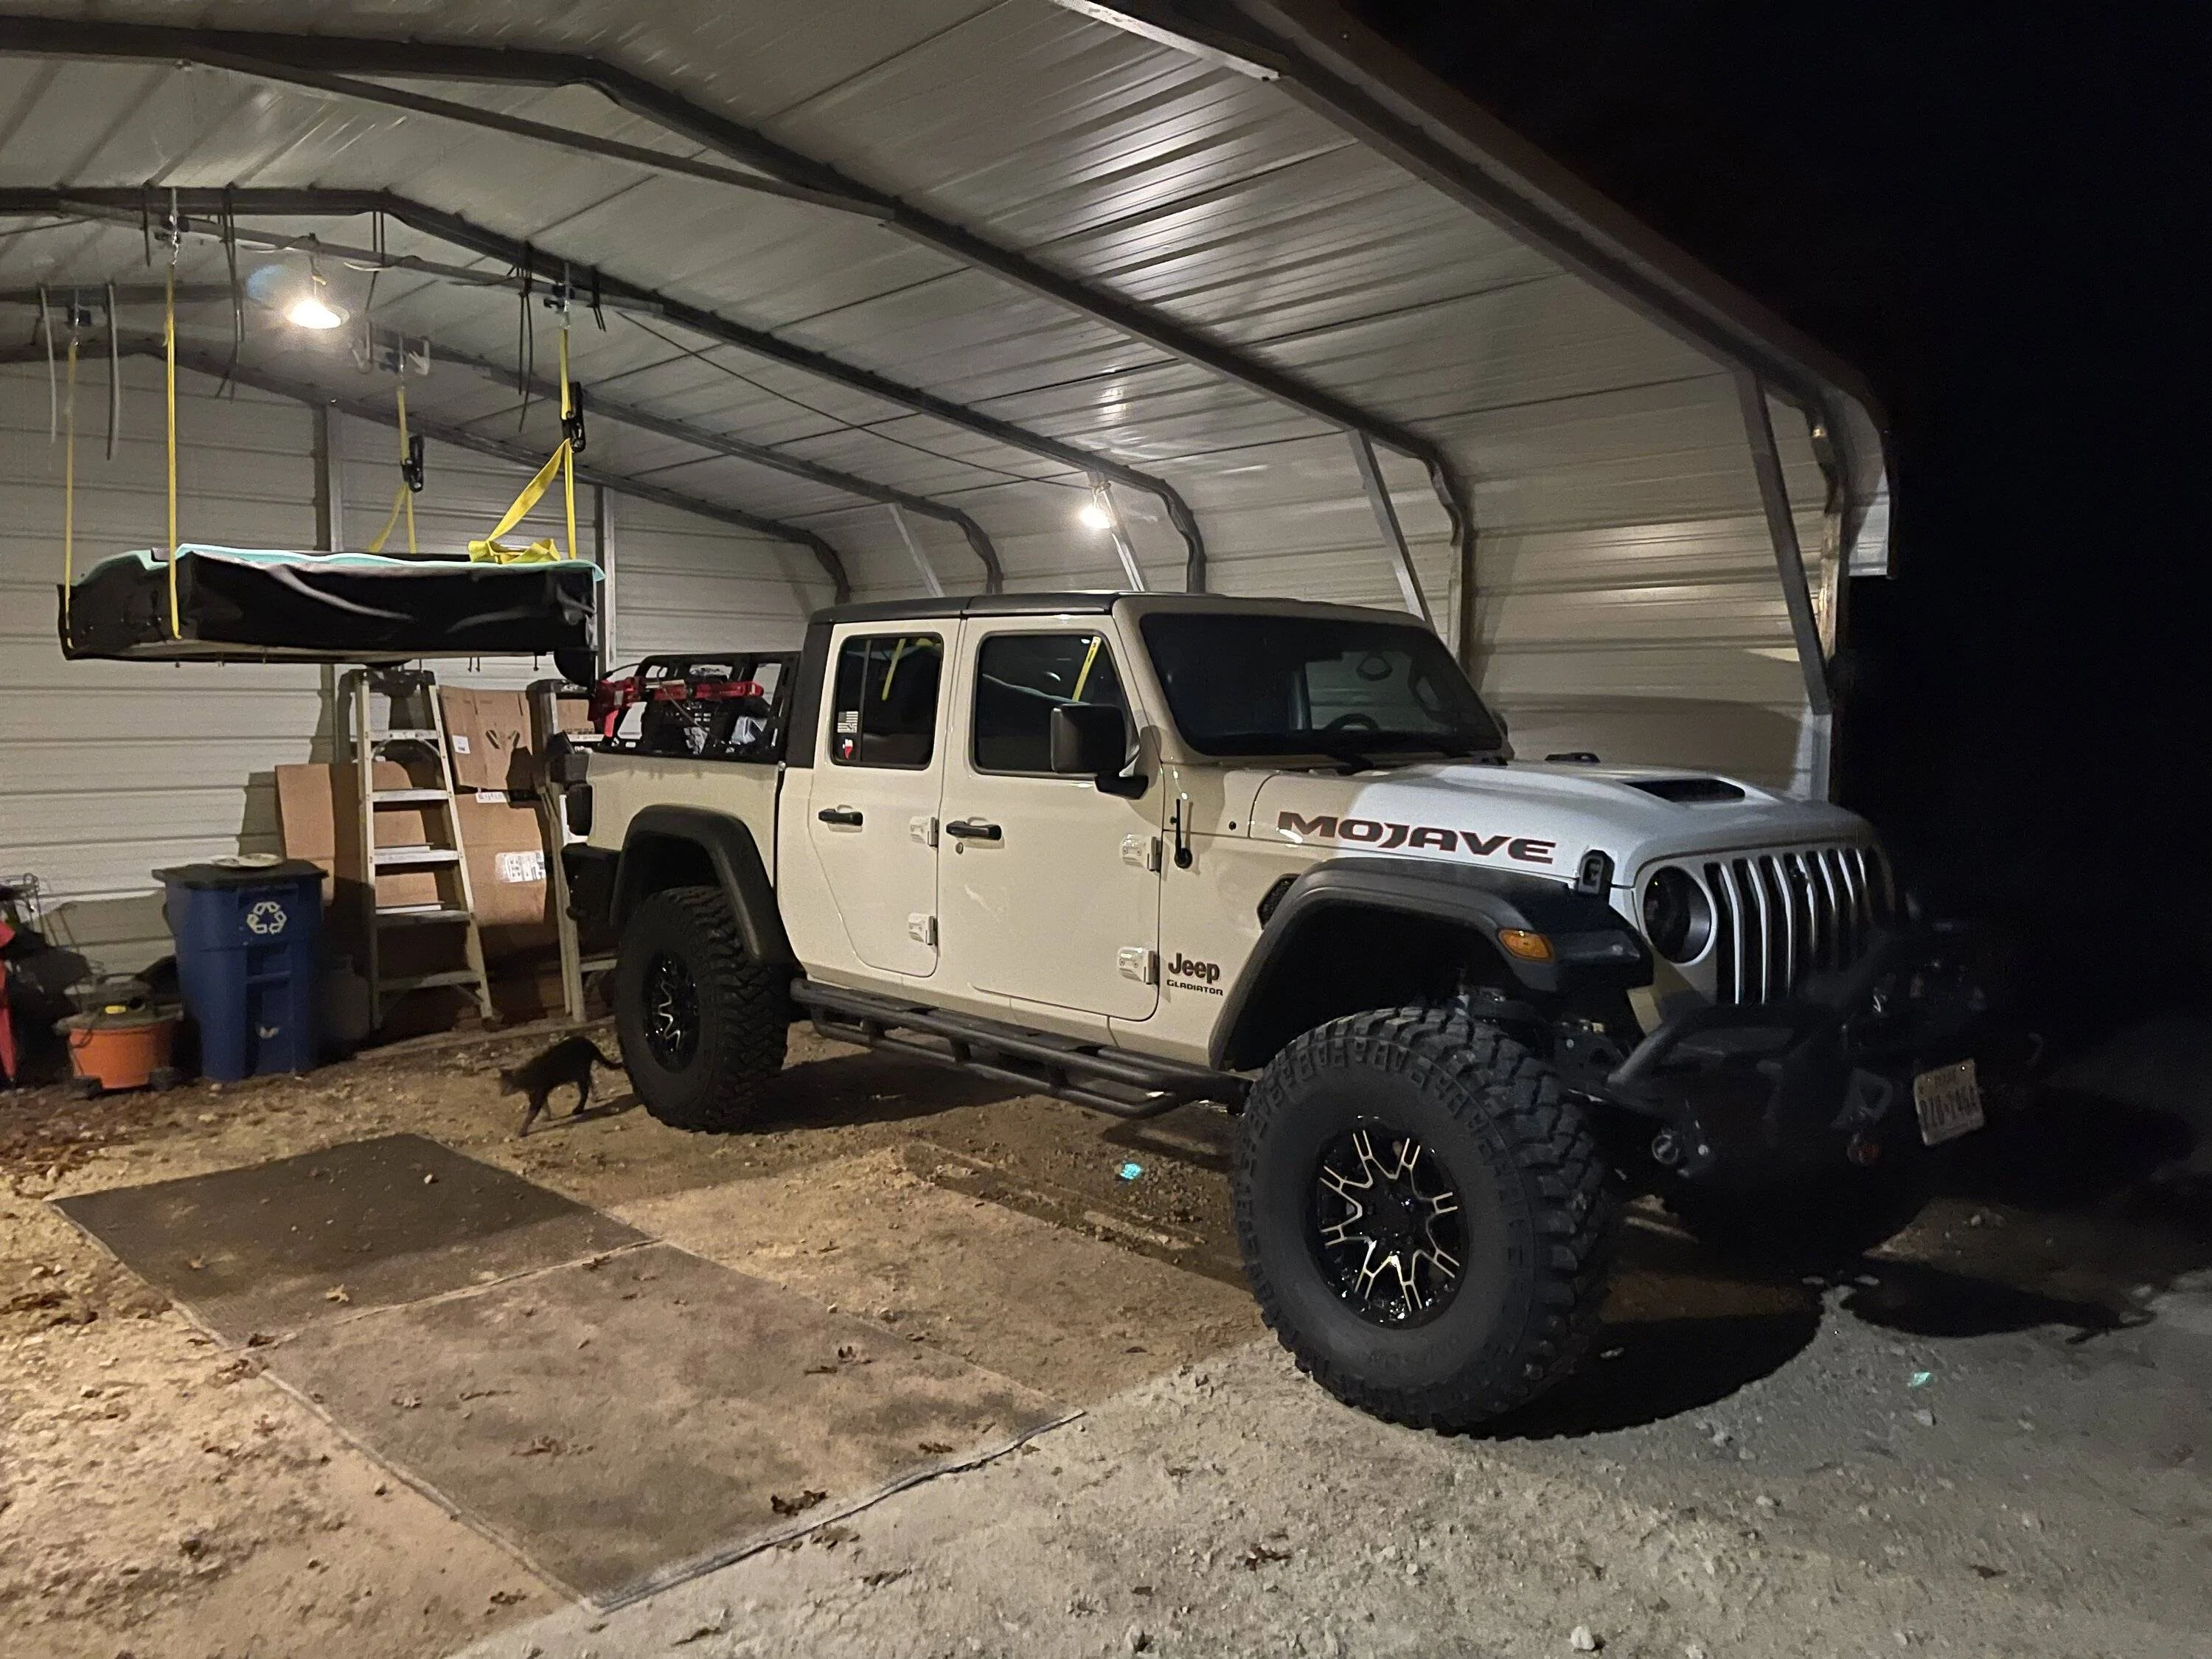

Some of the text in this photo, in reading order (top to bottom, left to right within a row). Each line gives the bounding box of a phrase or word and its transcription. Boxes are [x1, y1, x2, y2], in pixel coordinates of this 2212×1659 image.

[1277, 811, 1557, 865] MOJAVE
[1167, 952, 1220, 984] Jeep
[1166, 979, 1224, 996] GLADIATOR
